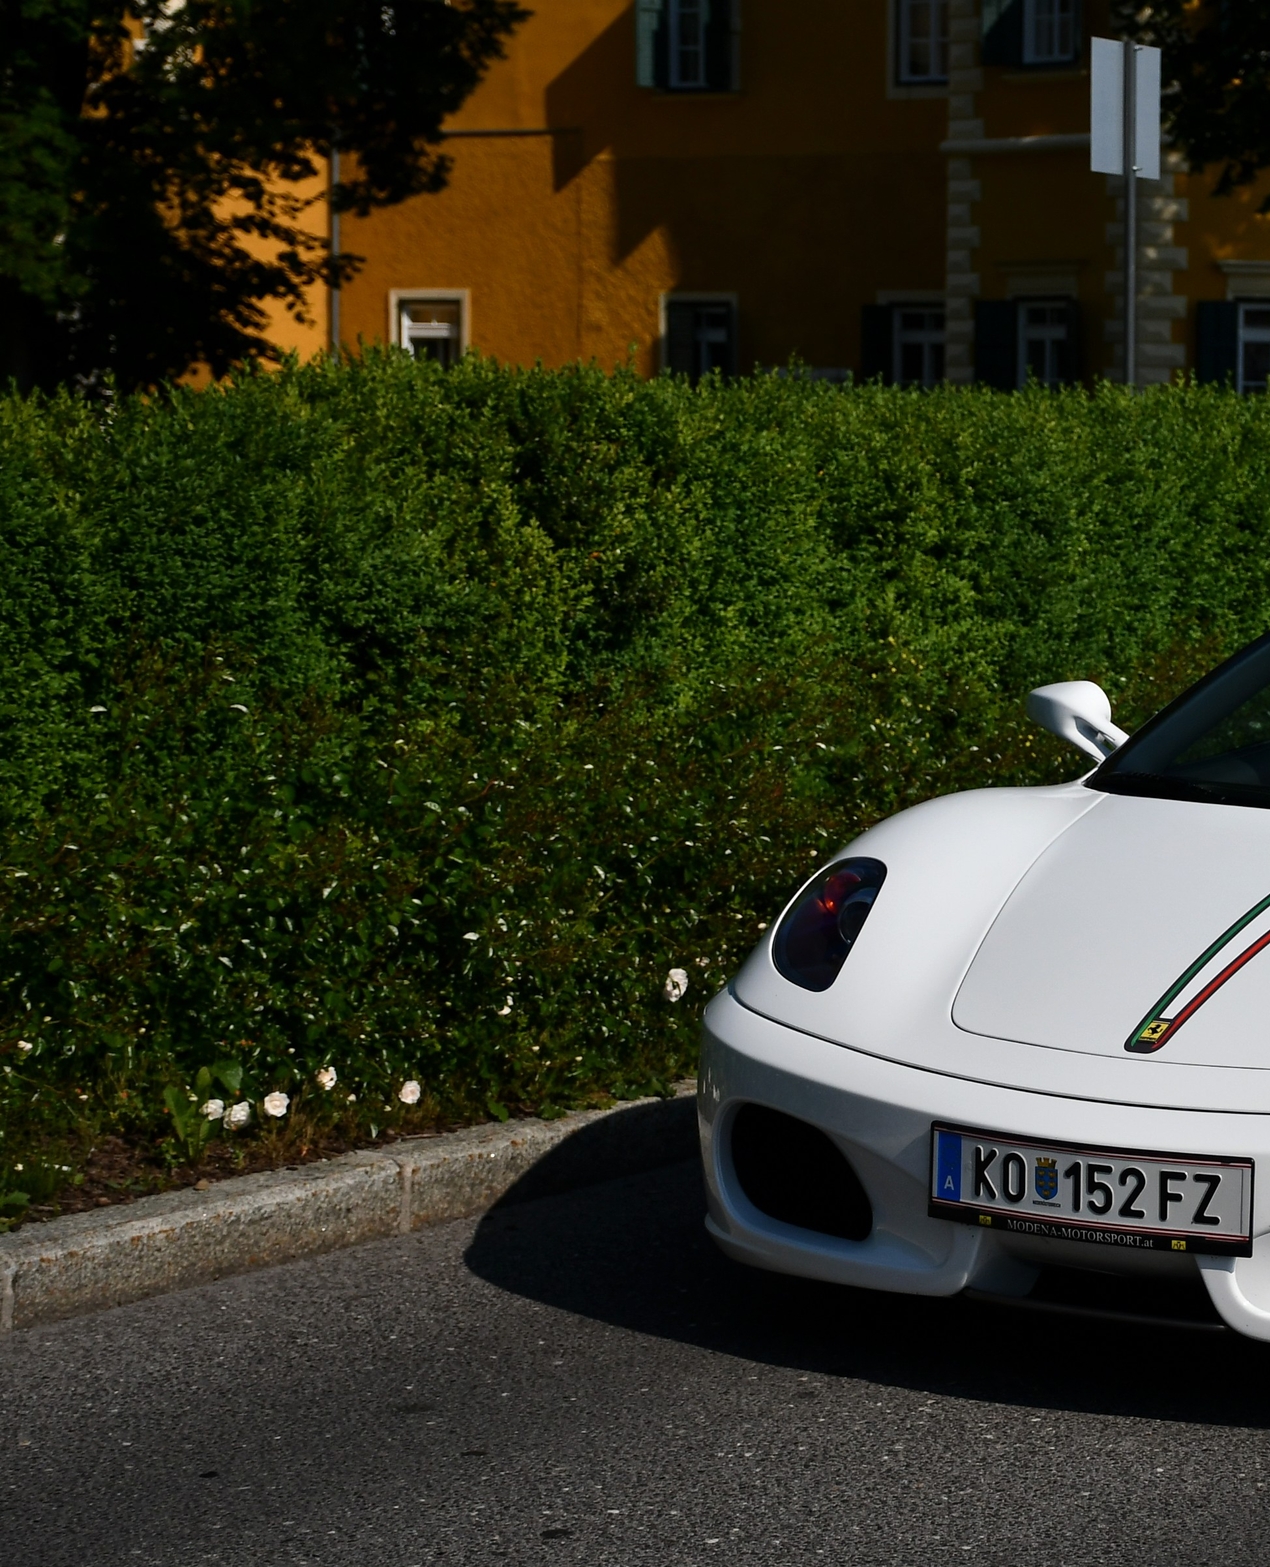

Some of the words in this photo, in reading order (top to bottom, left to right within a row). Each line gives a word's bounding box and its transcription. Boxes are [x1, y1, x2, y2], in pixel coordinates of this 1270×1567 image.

[943, 1175, 955, 1190] A
[974, 1144, 1027, 1202] KO
[1065, 1160, 1146, 1219] 152
[1159, 1170, 1222, 1226] FZ
[1007, 1219, 1153, 1248] MODENA-MOTORSPORT.at
